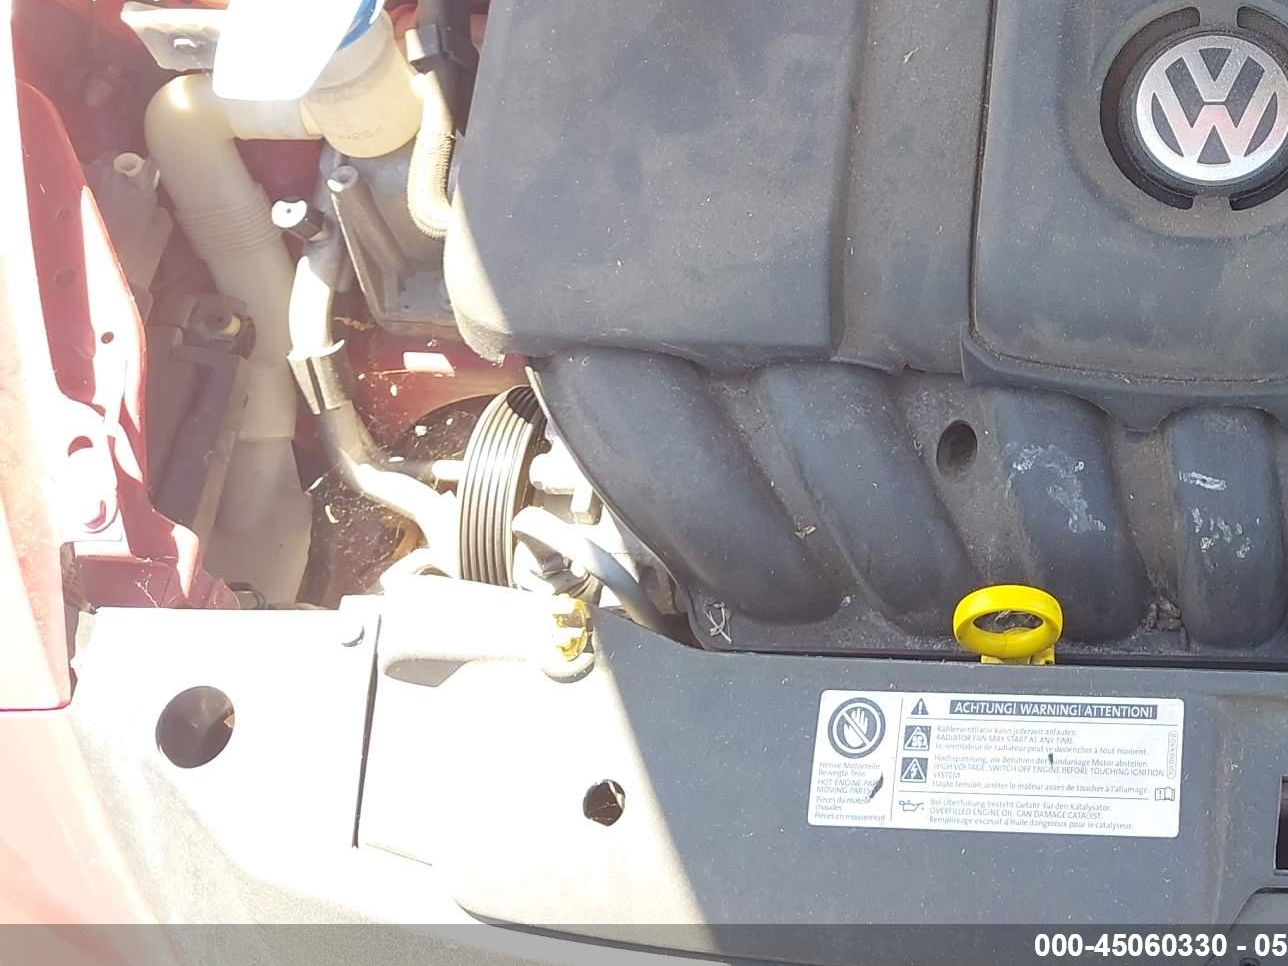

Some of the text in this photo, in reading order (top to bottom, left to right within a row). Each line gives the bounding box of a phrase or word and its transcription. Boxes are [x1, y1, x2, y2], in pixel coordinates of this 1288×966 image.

[955, 701, 1153, 719] ACHTUNG! WARNING! ATTENTION!
